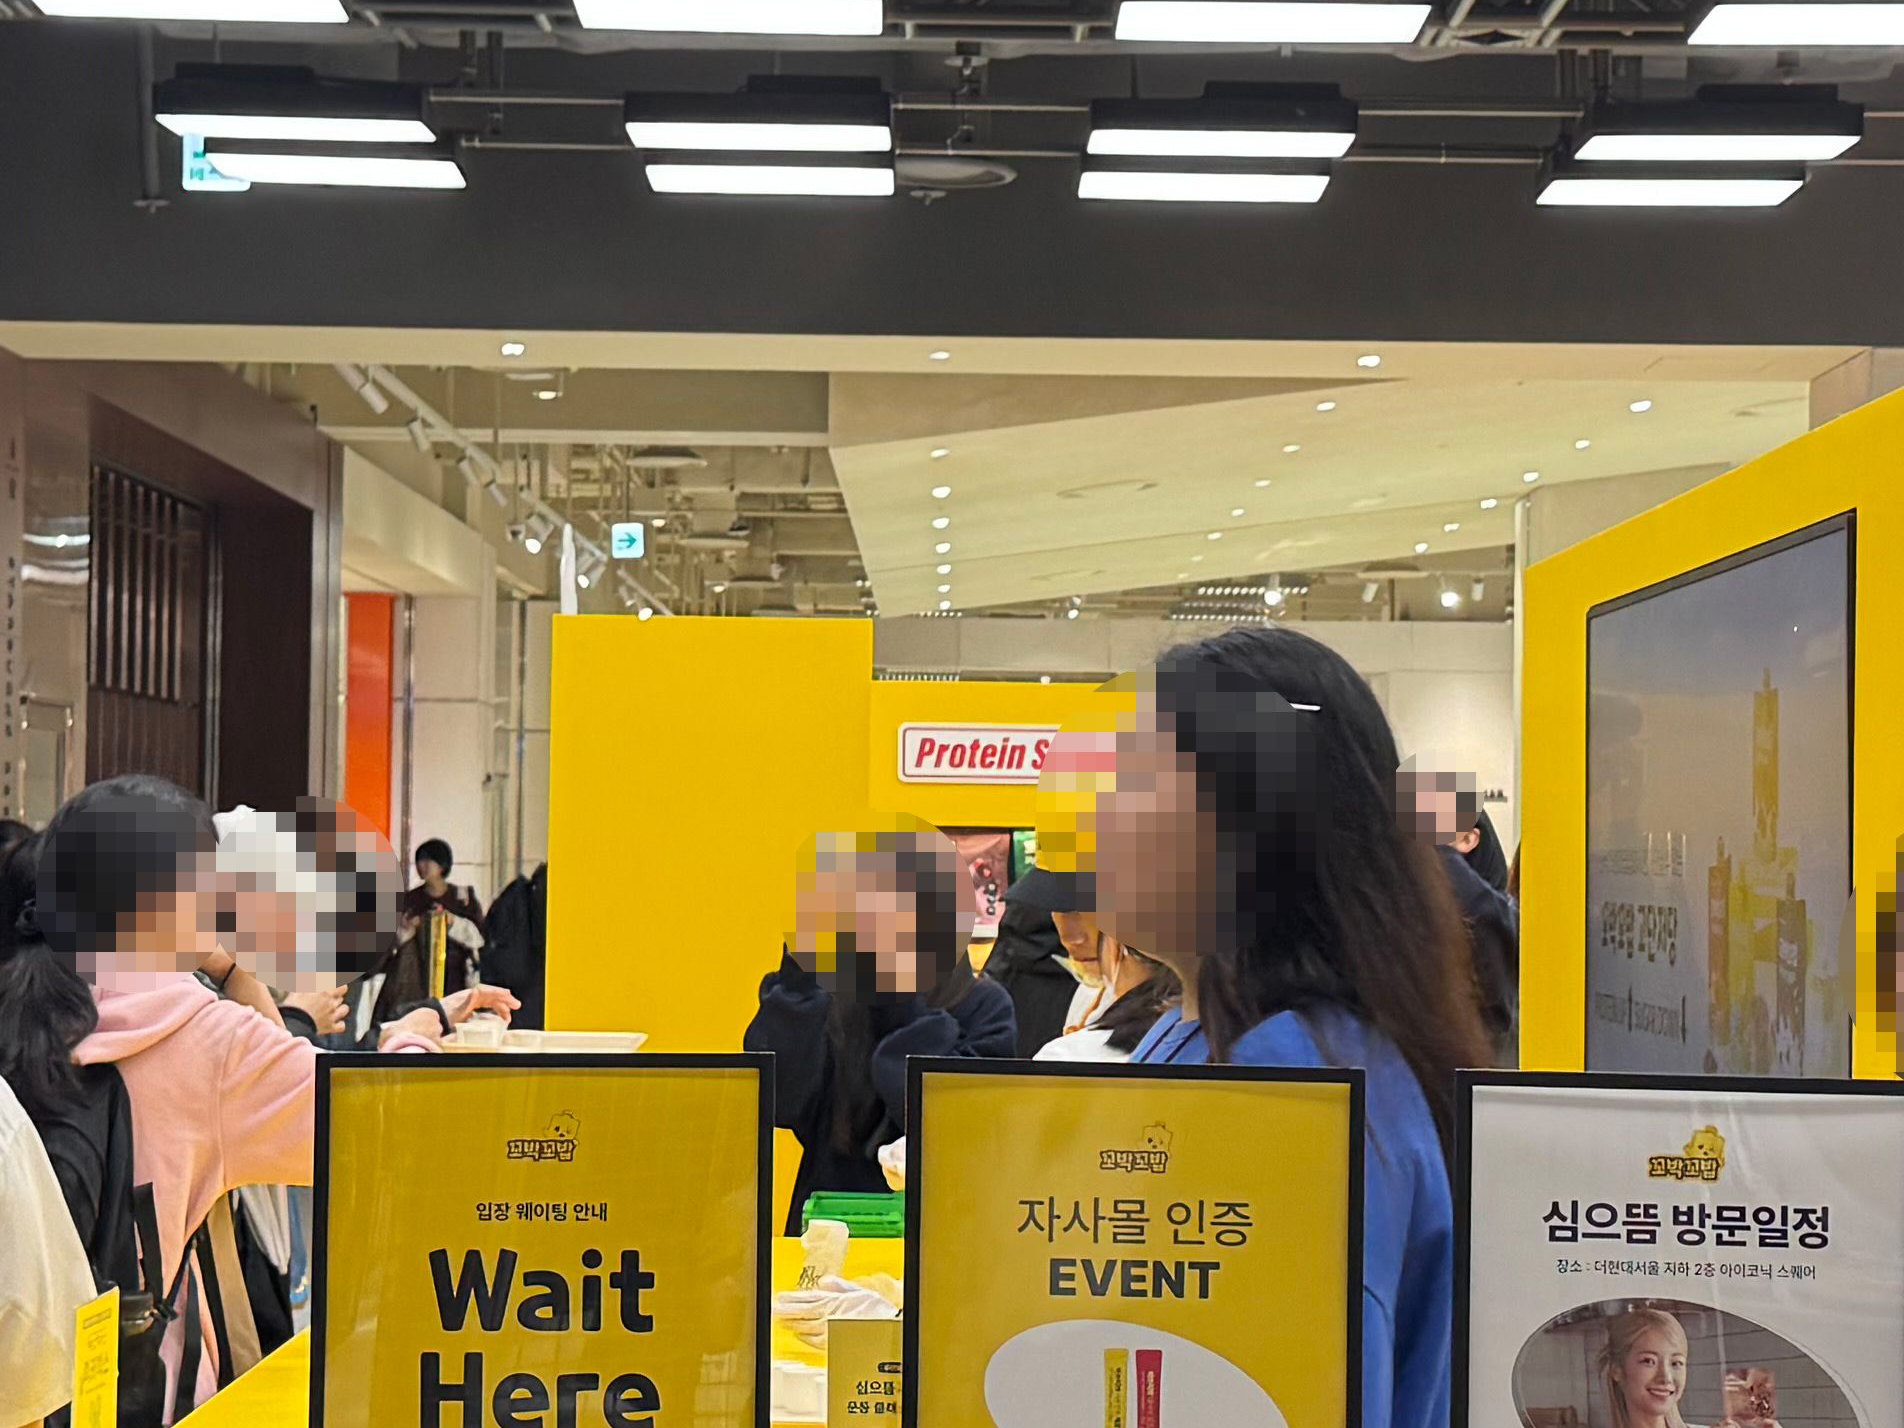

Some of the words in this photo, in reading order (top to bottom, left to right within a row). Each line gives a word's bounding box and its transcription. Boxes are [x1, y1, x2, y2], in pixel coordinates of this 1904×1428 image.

[915, 737, 1026, 770] Protein
[476, 1202, 509, 1221] 입장
[516, 1202, 567, 1221] 웨이팅
[573, 1202, 607, 1221] 안내
[1017, 1196, 1150, 1244] 자사몰
[1166, 1200, 1253, 1246] 인증
[1542, 1200, 1661, 1244] 심으뜸
[1672, 1203, 1829, 1249] 방문일정
[1049, 1258, 1220, 1299] EVENT
[1557, 1259, 1582, 1274] 장소
[1664, 1262, 1690, 1277] 지하
[1695, 1263, 1714, 1278] 2층
[1720, 1263, 1772, 1279] 아이코닉
[428, 1247, 655, 1333] Wait
